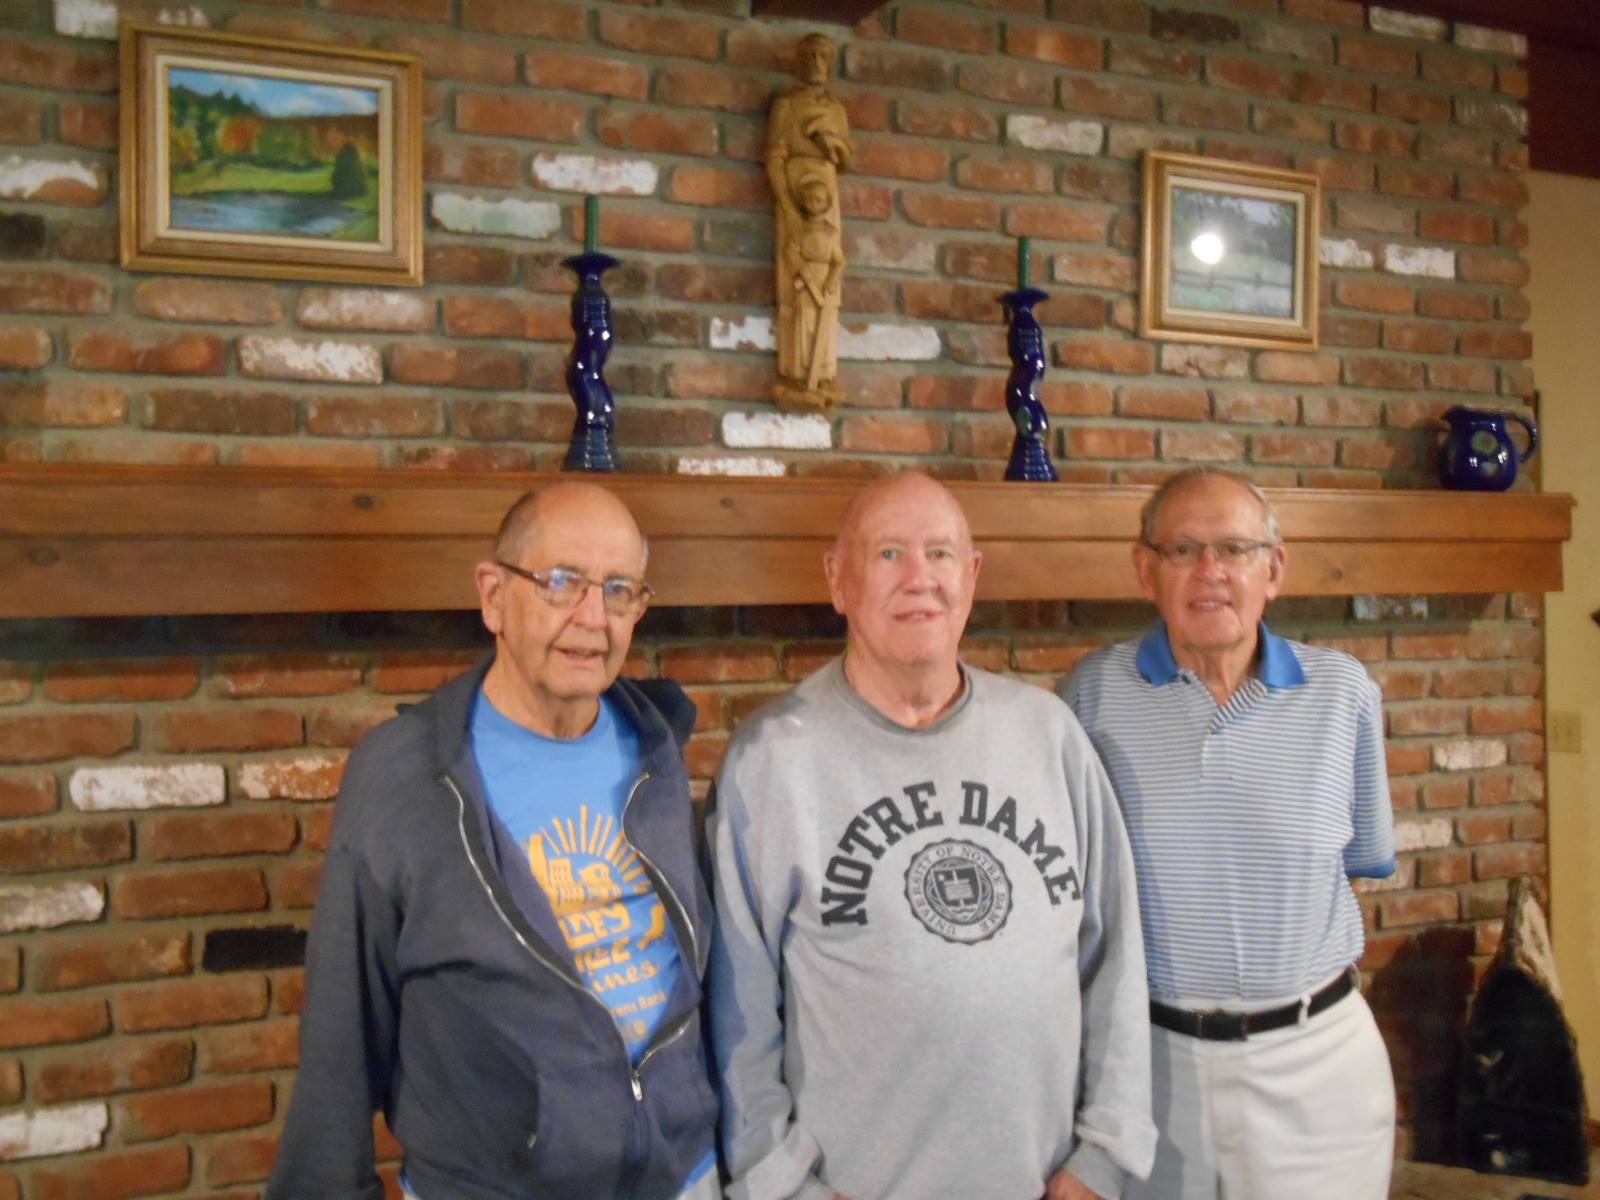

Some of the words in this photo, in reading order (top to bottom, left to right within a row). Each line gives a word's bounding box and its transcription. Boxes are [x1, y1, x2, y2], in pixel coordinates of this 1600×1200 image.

[820, 781, 944, 926] NOTRE
[959, 780, 1083, 906] DAME
[936, 846, 954, 858] OF
[961, 847, 1001, 883] NOTRE
[911, 853, 957, 935] UNIVERSITY
[979, 892, 1006, 933] DAME
